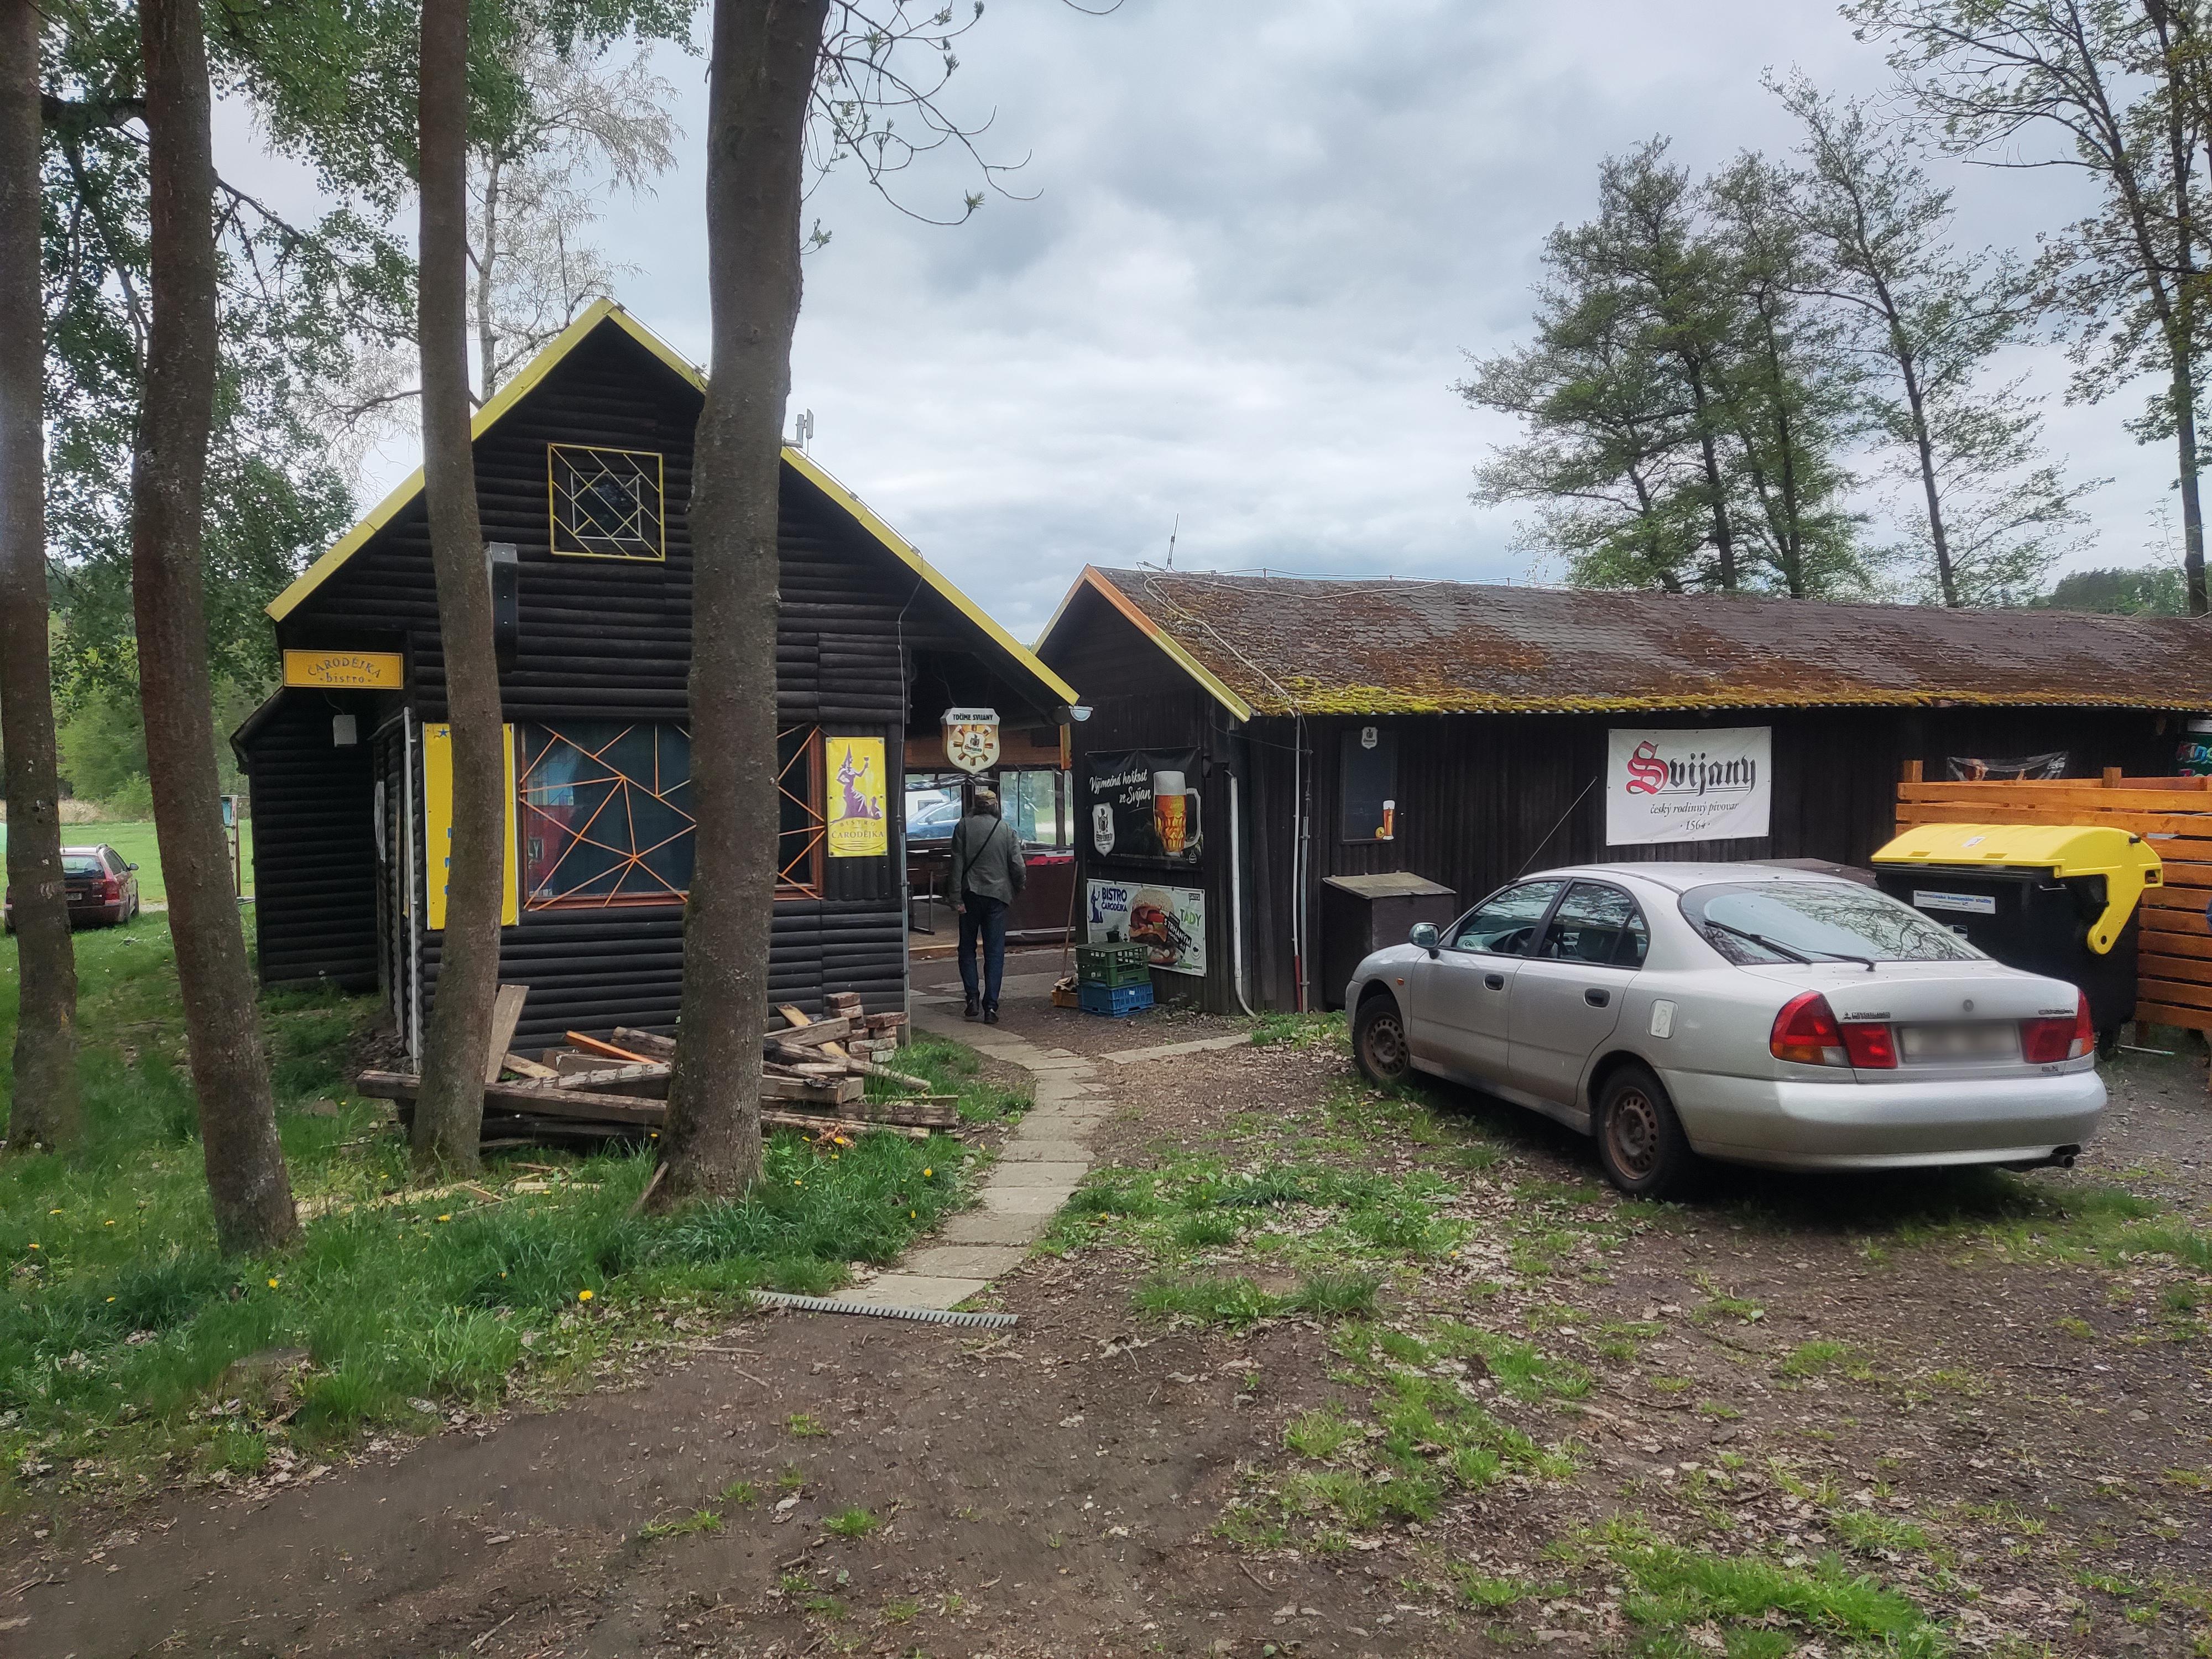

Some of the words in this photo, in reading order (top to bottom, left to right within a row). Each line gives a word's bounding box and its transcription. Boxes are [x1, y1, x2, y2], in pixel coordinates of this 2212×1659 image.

[326, 672, 365, 684] bistro
[1122, 768, 1147, 785] hořkost
[1626, 740, 1757, 797] Svijany
[1119, 792, 1126, 804] ze
[1126, 786, 1151, 808] Svijan
[1650, 803, 1672, 818] český
[1673, 801, 1707, 816] rodinný
[1708, 801, 1739, 816] pivovar
[1686, 819, 1707, 830] 1564
[831, 830, 884, 839] ČARODĚJKA
[1102, 887, 1128, 902] BISTRO
[1180, 908, 1202, 927] TADY
[1168, 920, 1191, 948] TRHANÝM
